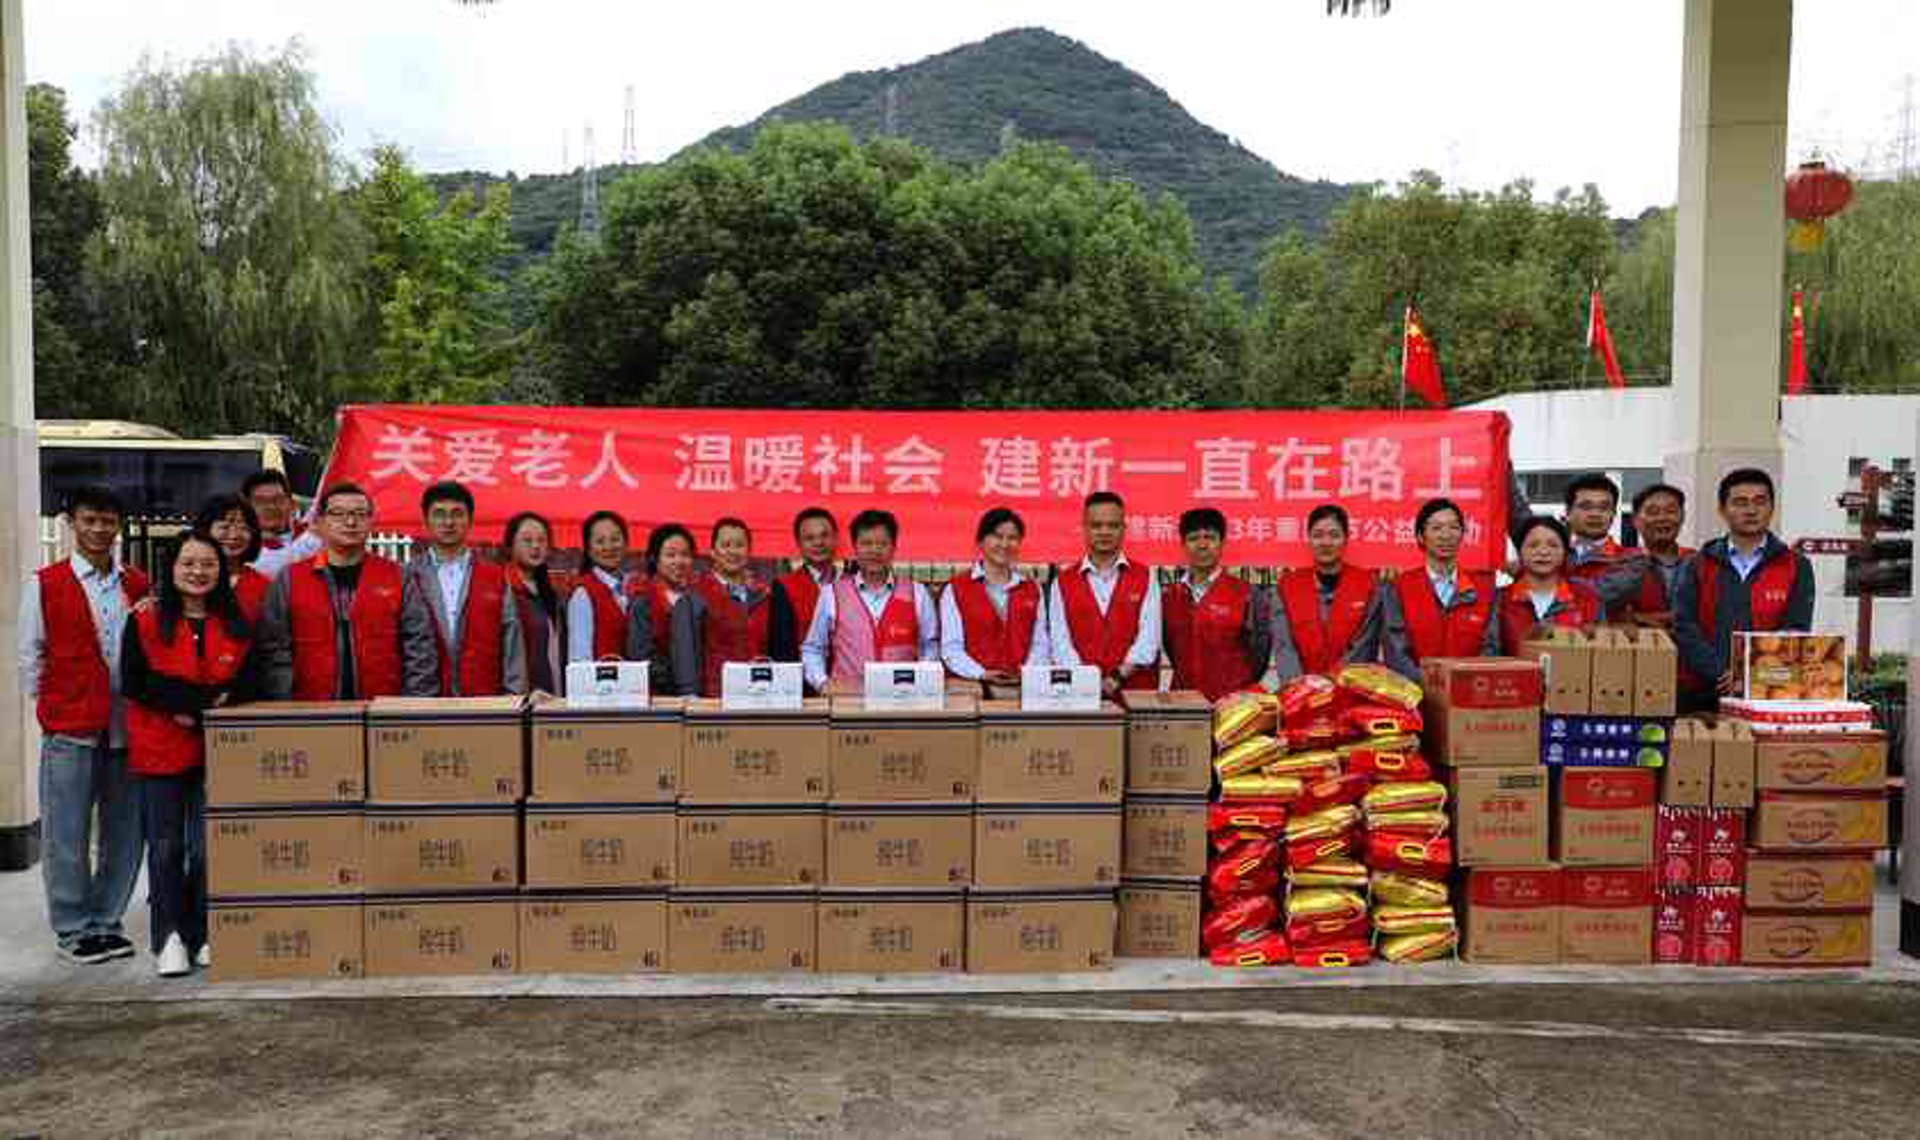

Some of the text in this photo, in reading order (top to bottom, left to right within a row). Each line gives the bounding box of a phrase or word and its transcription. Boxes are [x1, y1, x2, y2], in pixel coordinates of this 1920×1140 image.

[370, 425, 1484, 502] 关爱老人 温暖社会 建新一直在路上
